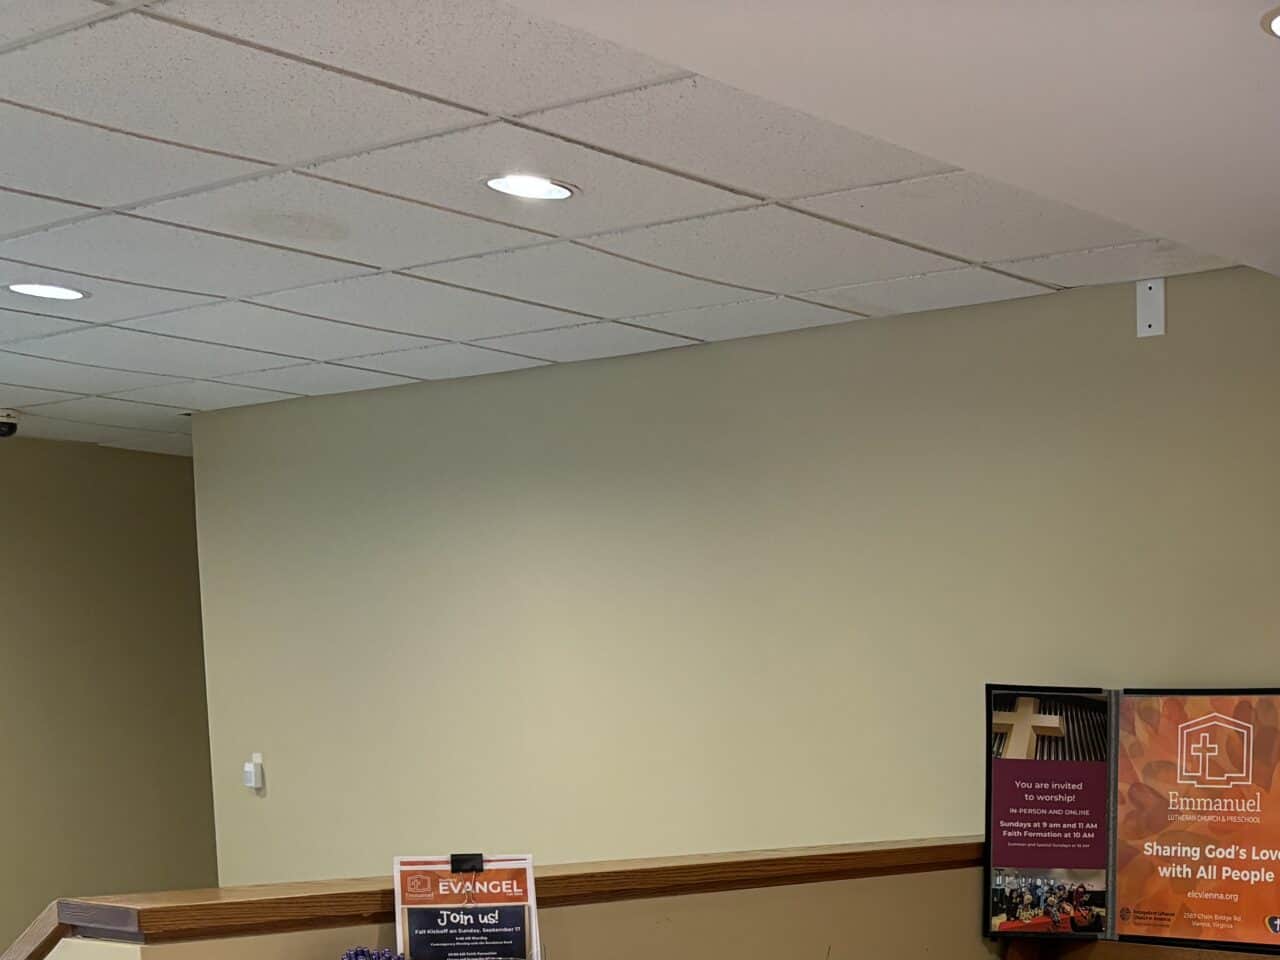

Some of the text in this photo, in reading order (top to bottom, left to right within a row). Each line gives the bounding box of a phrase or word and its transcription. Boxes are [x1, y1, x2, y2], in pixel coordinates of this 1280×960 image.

[1015, 780, 1033, 789] You
[1051, 781, 1083, 790] invited
[1024, 793, 1076, 803] to worship!
[1168, 791, 1262, 813] Emmanuel
[999, 820, 1031, 829] Sundays
[1023, 830, 1062, 838] Formation
[1143, 841, 1200, 861] Sharing
[1204, 844, 1247, 860] God's
[1158, 863, 1275, 884] with All People
[438, 879, 523, 895] EVANGEL
[1187, 889, 1239, 902] elcvienna.org
[437, 909, 499, 926] Join us!
